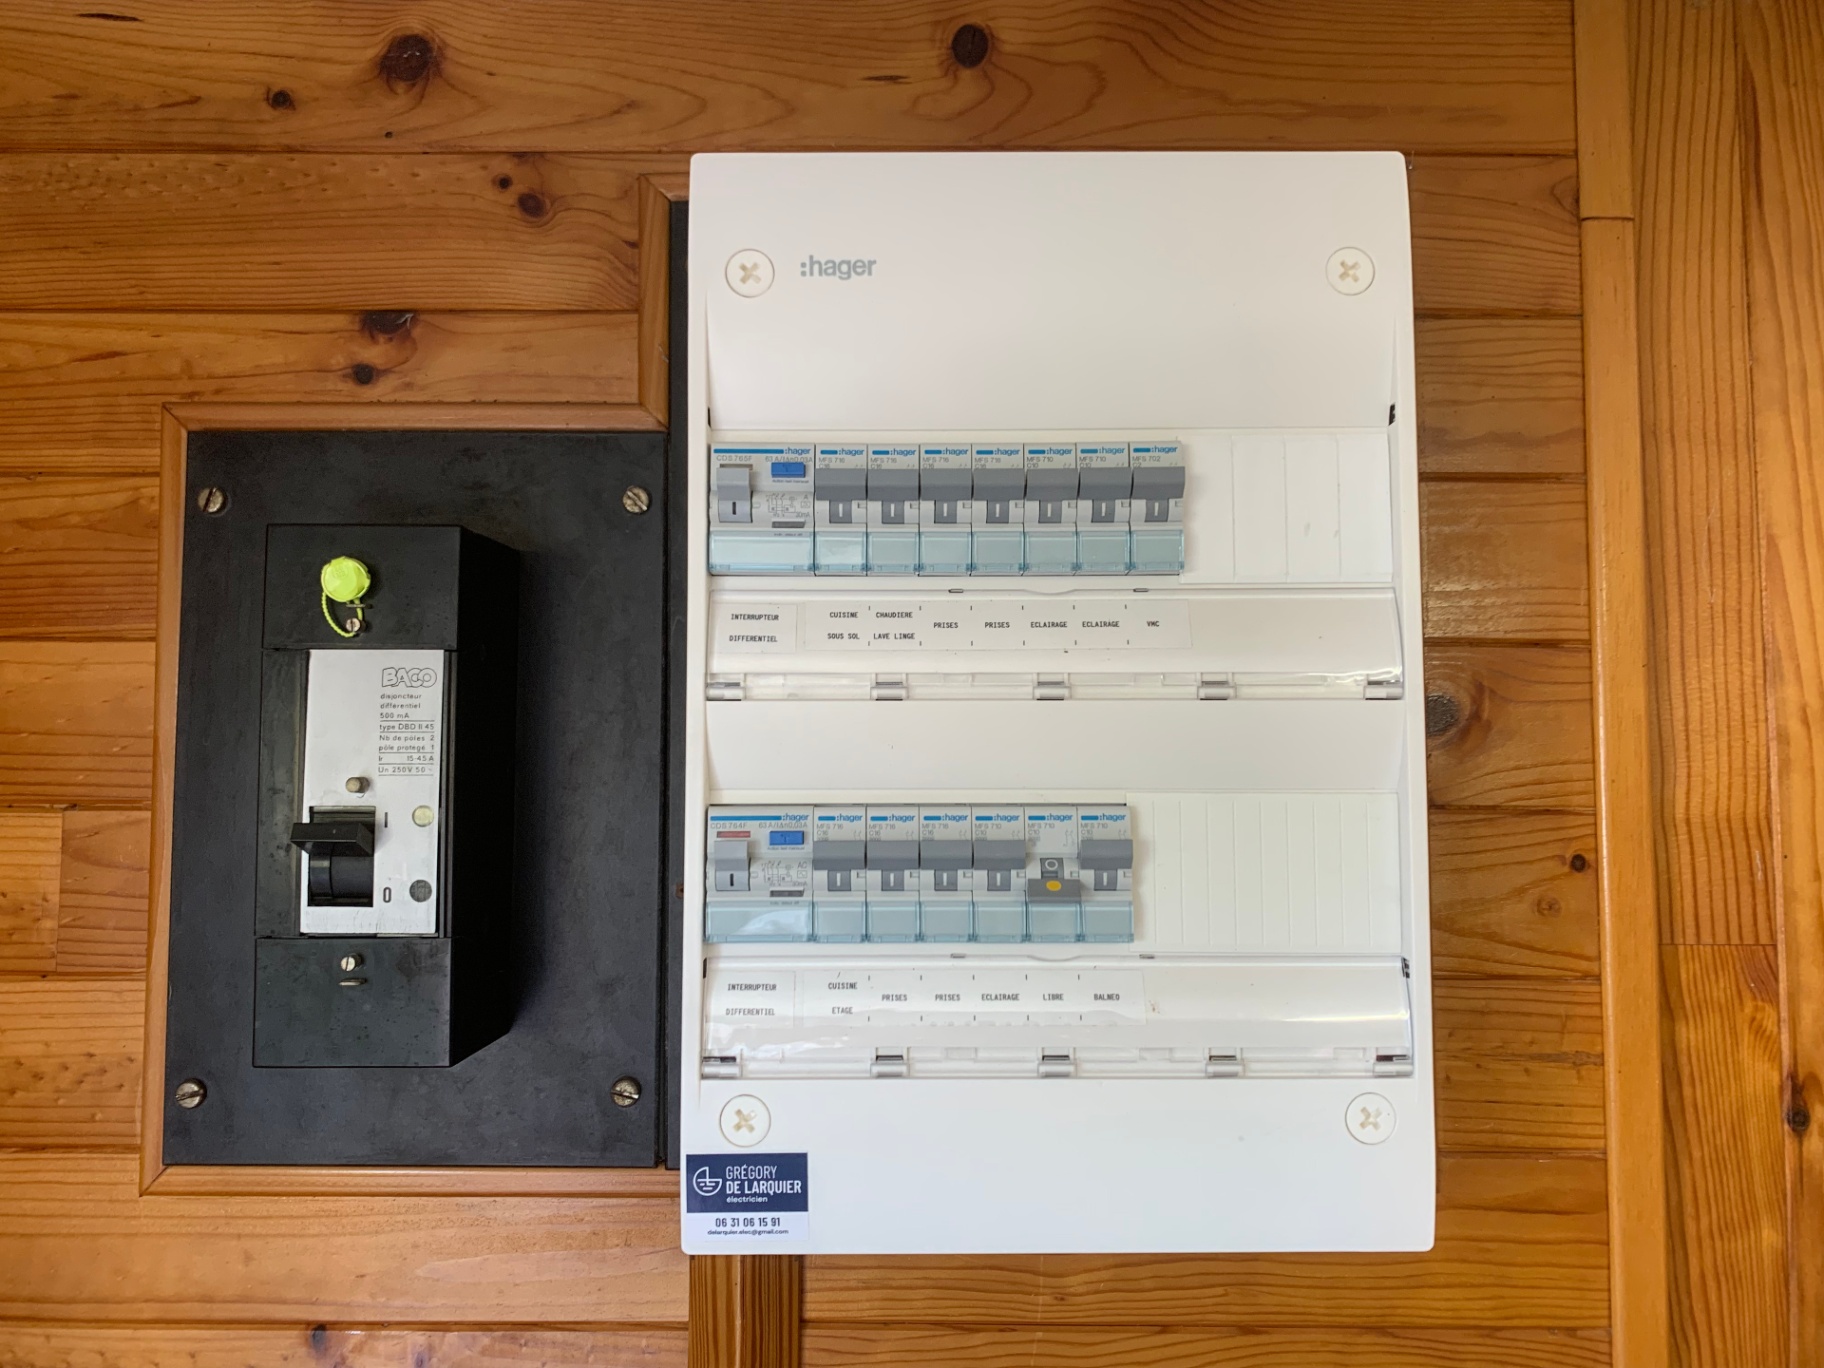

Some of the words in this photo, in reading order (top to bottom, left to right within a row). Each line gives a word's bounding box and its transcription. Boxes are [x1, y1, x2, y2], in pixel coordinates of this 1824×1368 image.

[731, 613, 779, 621] INTERRUPTEUR
[382, 667, 438, 688] BACO
[380, 693, 422, 701] disjoncteur
[728, 983, 777, 991] INTERRUPTEUR
[828, 982, 858, 990] CUISINE
[882, 994, 907, 1002] PRISES
[726, 1008, 775, 1016] DIFFERENTIEL
[726, 1164, 777, 1180] GRÉGORY
[726, 1181, 741, 1194] DE
[744, 1180, 802, 1195] LARQUIER
[726, 1195, 768, 1203] électricien
[715, 1217, 727, 1227] 06
[730, 1217, 740, 1227] 31
[743, 1217, 755, 1227] 06
[759, 1217, 768, 1227] 15
[771, 1217, 780, 1227] 91
